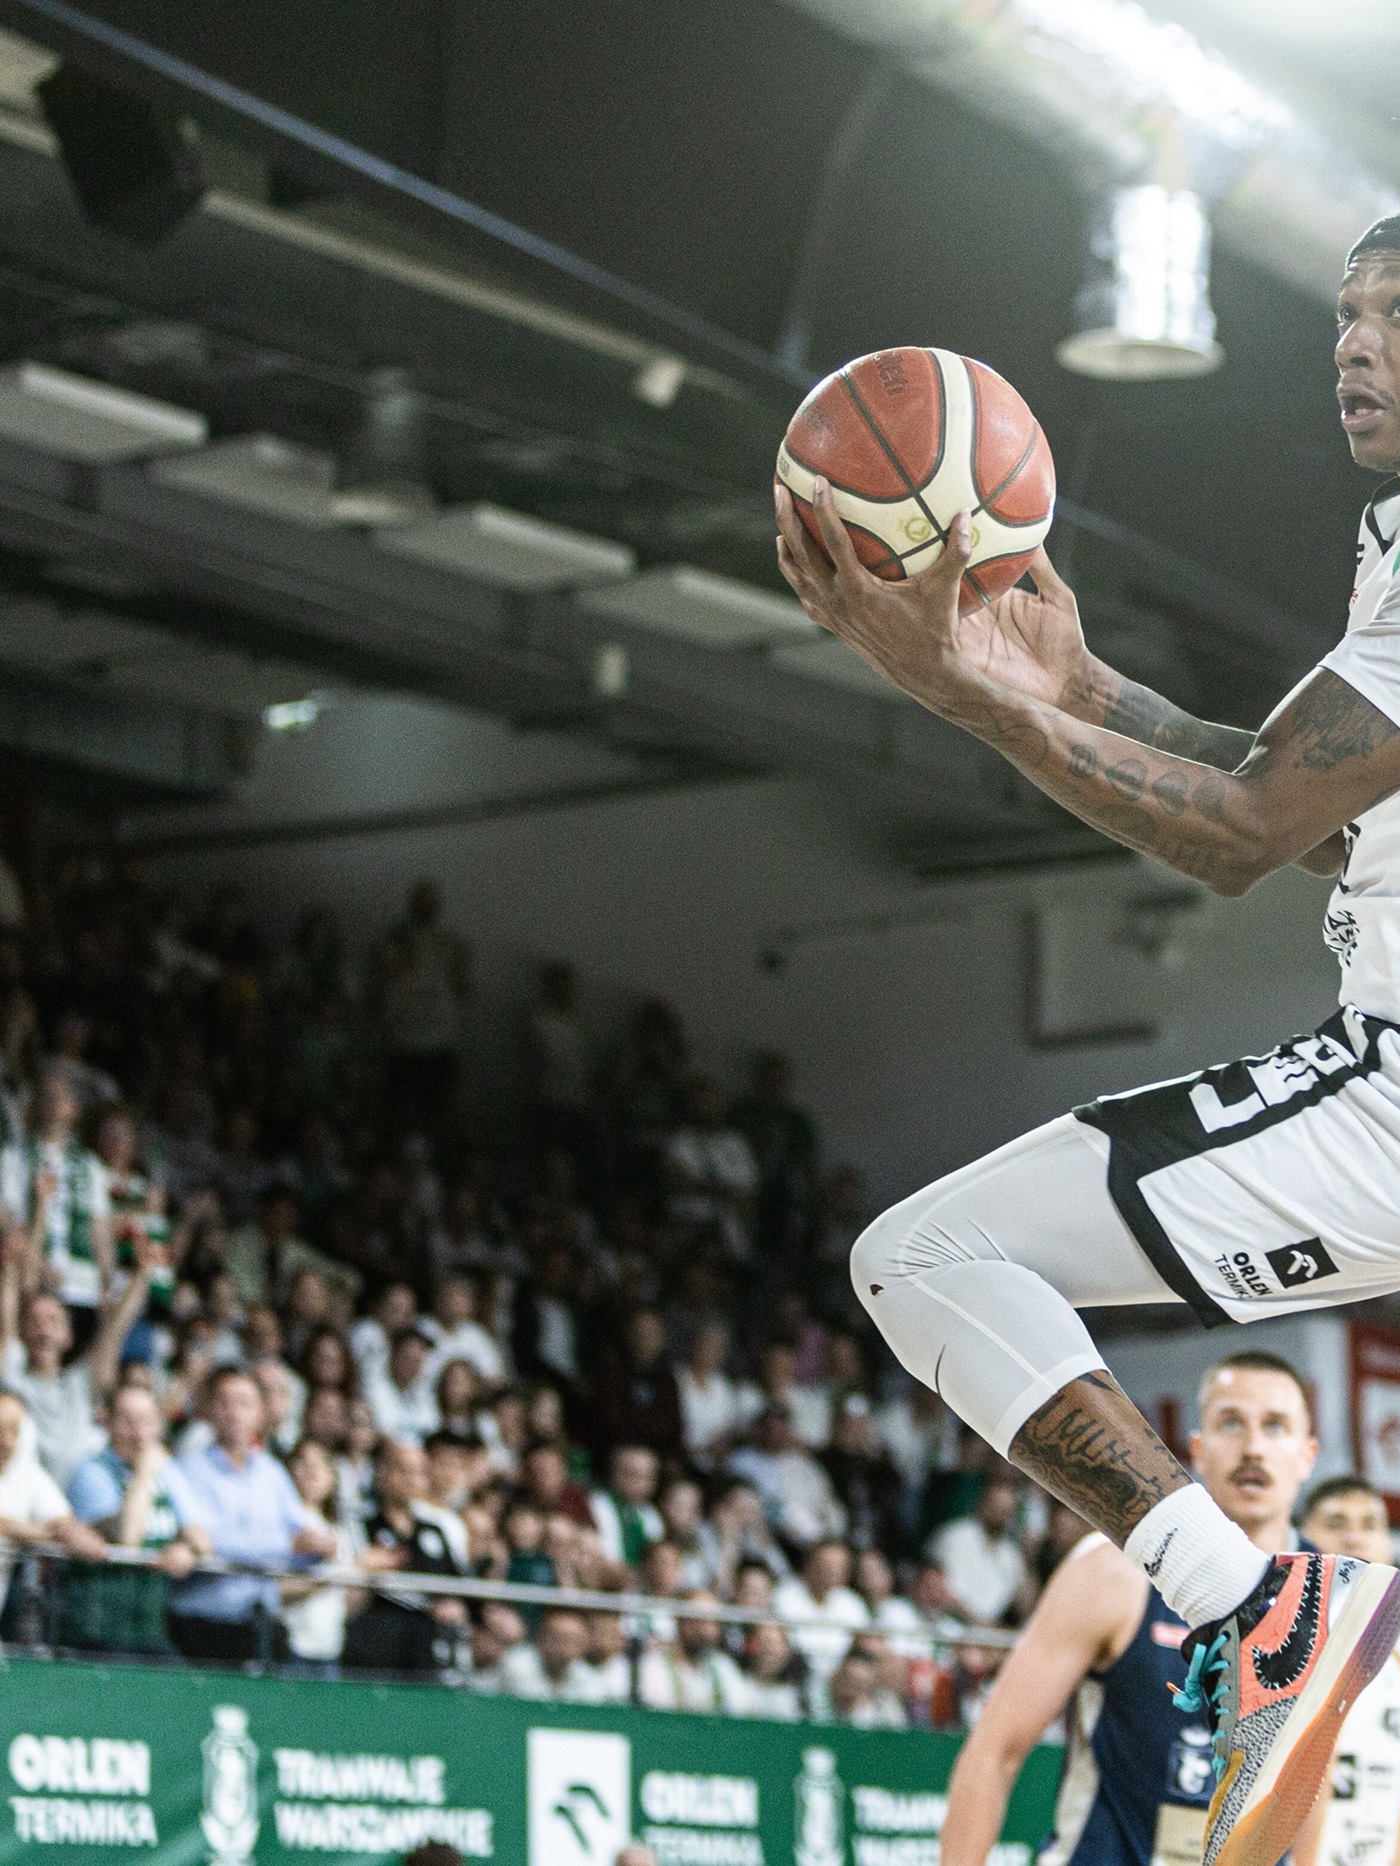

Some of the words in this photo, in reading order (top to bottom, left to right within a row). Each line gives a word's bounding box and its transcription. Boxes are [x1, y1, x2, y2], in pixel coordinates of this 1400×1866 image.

[1215, 1254, 1253, 1299] TERMIK
[1233, 1252, 1273, 1296] ORLEN
[9, 1733, 151, 1796] ORLEN
[10, 1796, 159, 1848] TERMIKA
